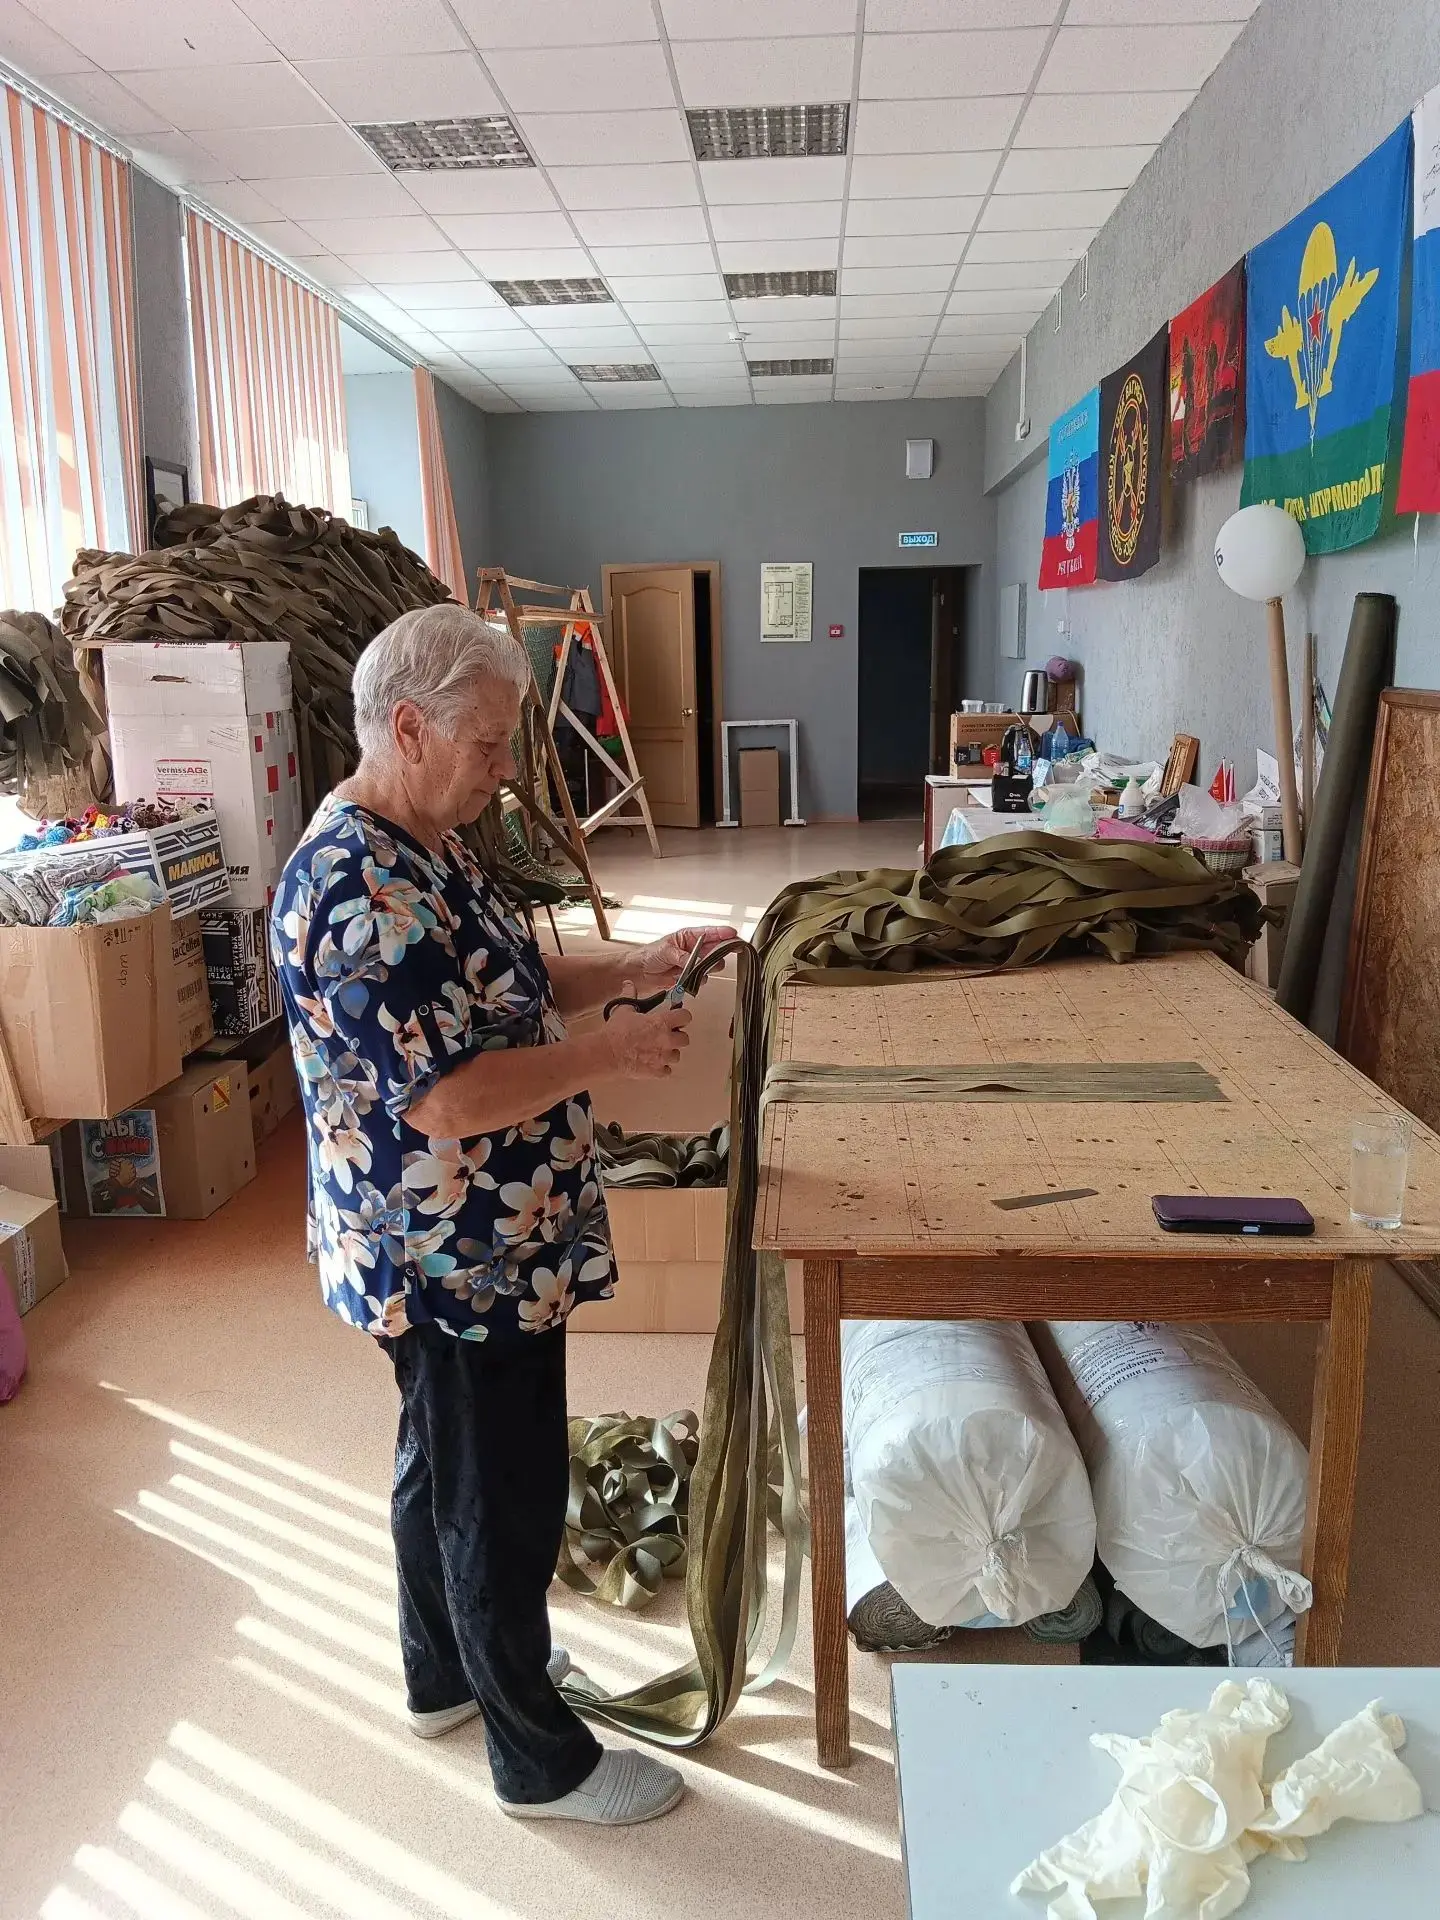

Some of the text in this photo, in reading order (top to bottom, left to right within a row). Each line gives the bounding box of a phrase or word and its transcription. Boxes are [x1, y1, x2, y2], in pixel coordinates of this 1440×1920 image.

[903, 535, 933, 544] ВЫХОД
[168, 851, 220, 881] MANNOL
[100, 1119, 136, 1139] МЫ
[90, 1139, 104, 1157] С
